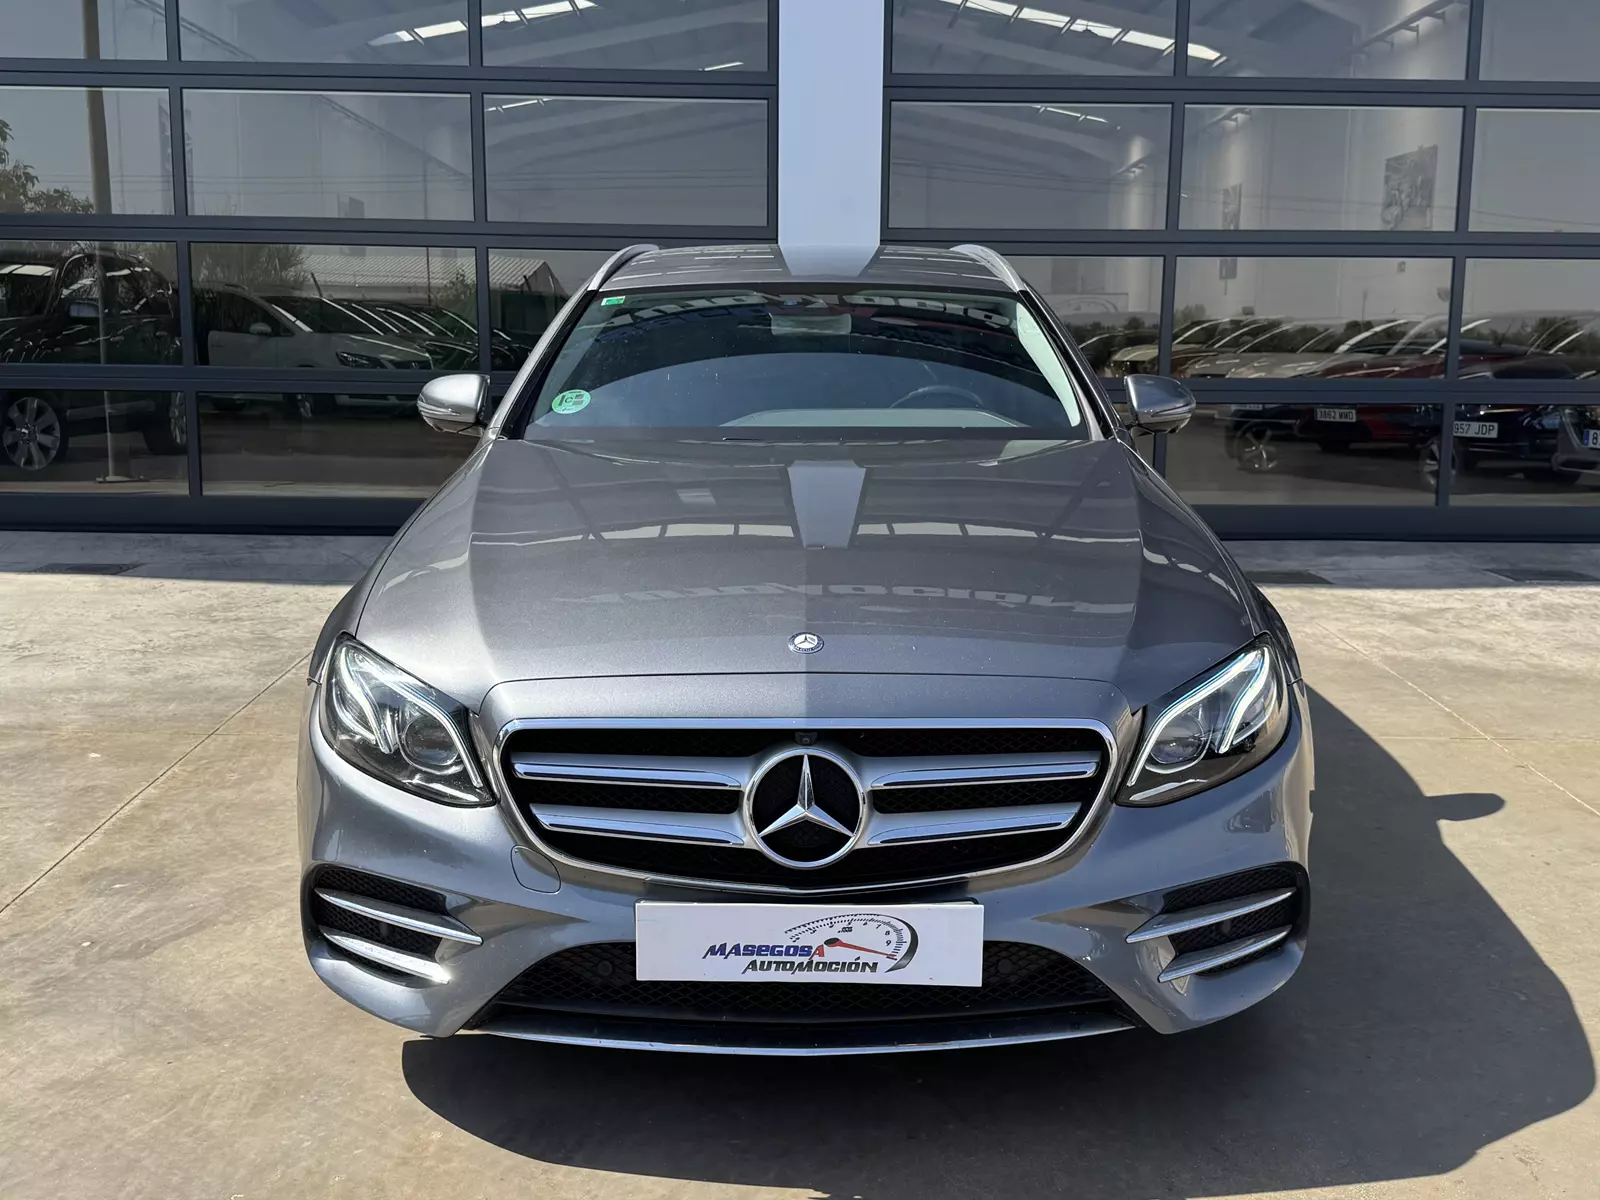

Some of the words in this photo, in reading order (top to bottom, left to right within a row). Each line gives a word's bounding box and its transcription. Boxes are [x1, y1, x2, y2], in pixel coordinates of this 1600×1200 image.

[1453, 423, 1471, 434] 957
[1474, 424, 1495, 436] JDP
[702, 942, 825, 960] MASEGOSA
[741, 956, 879, 974] AUTOMOCIÓN
